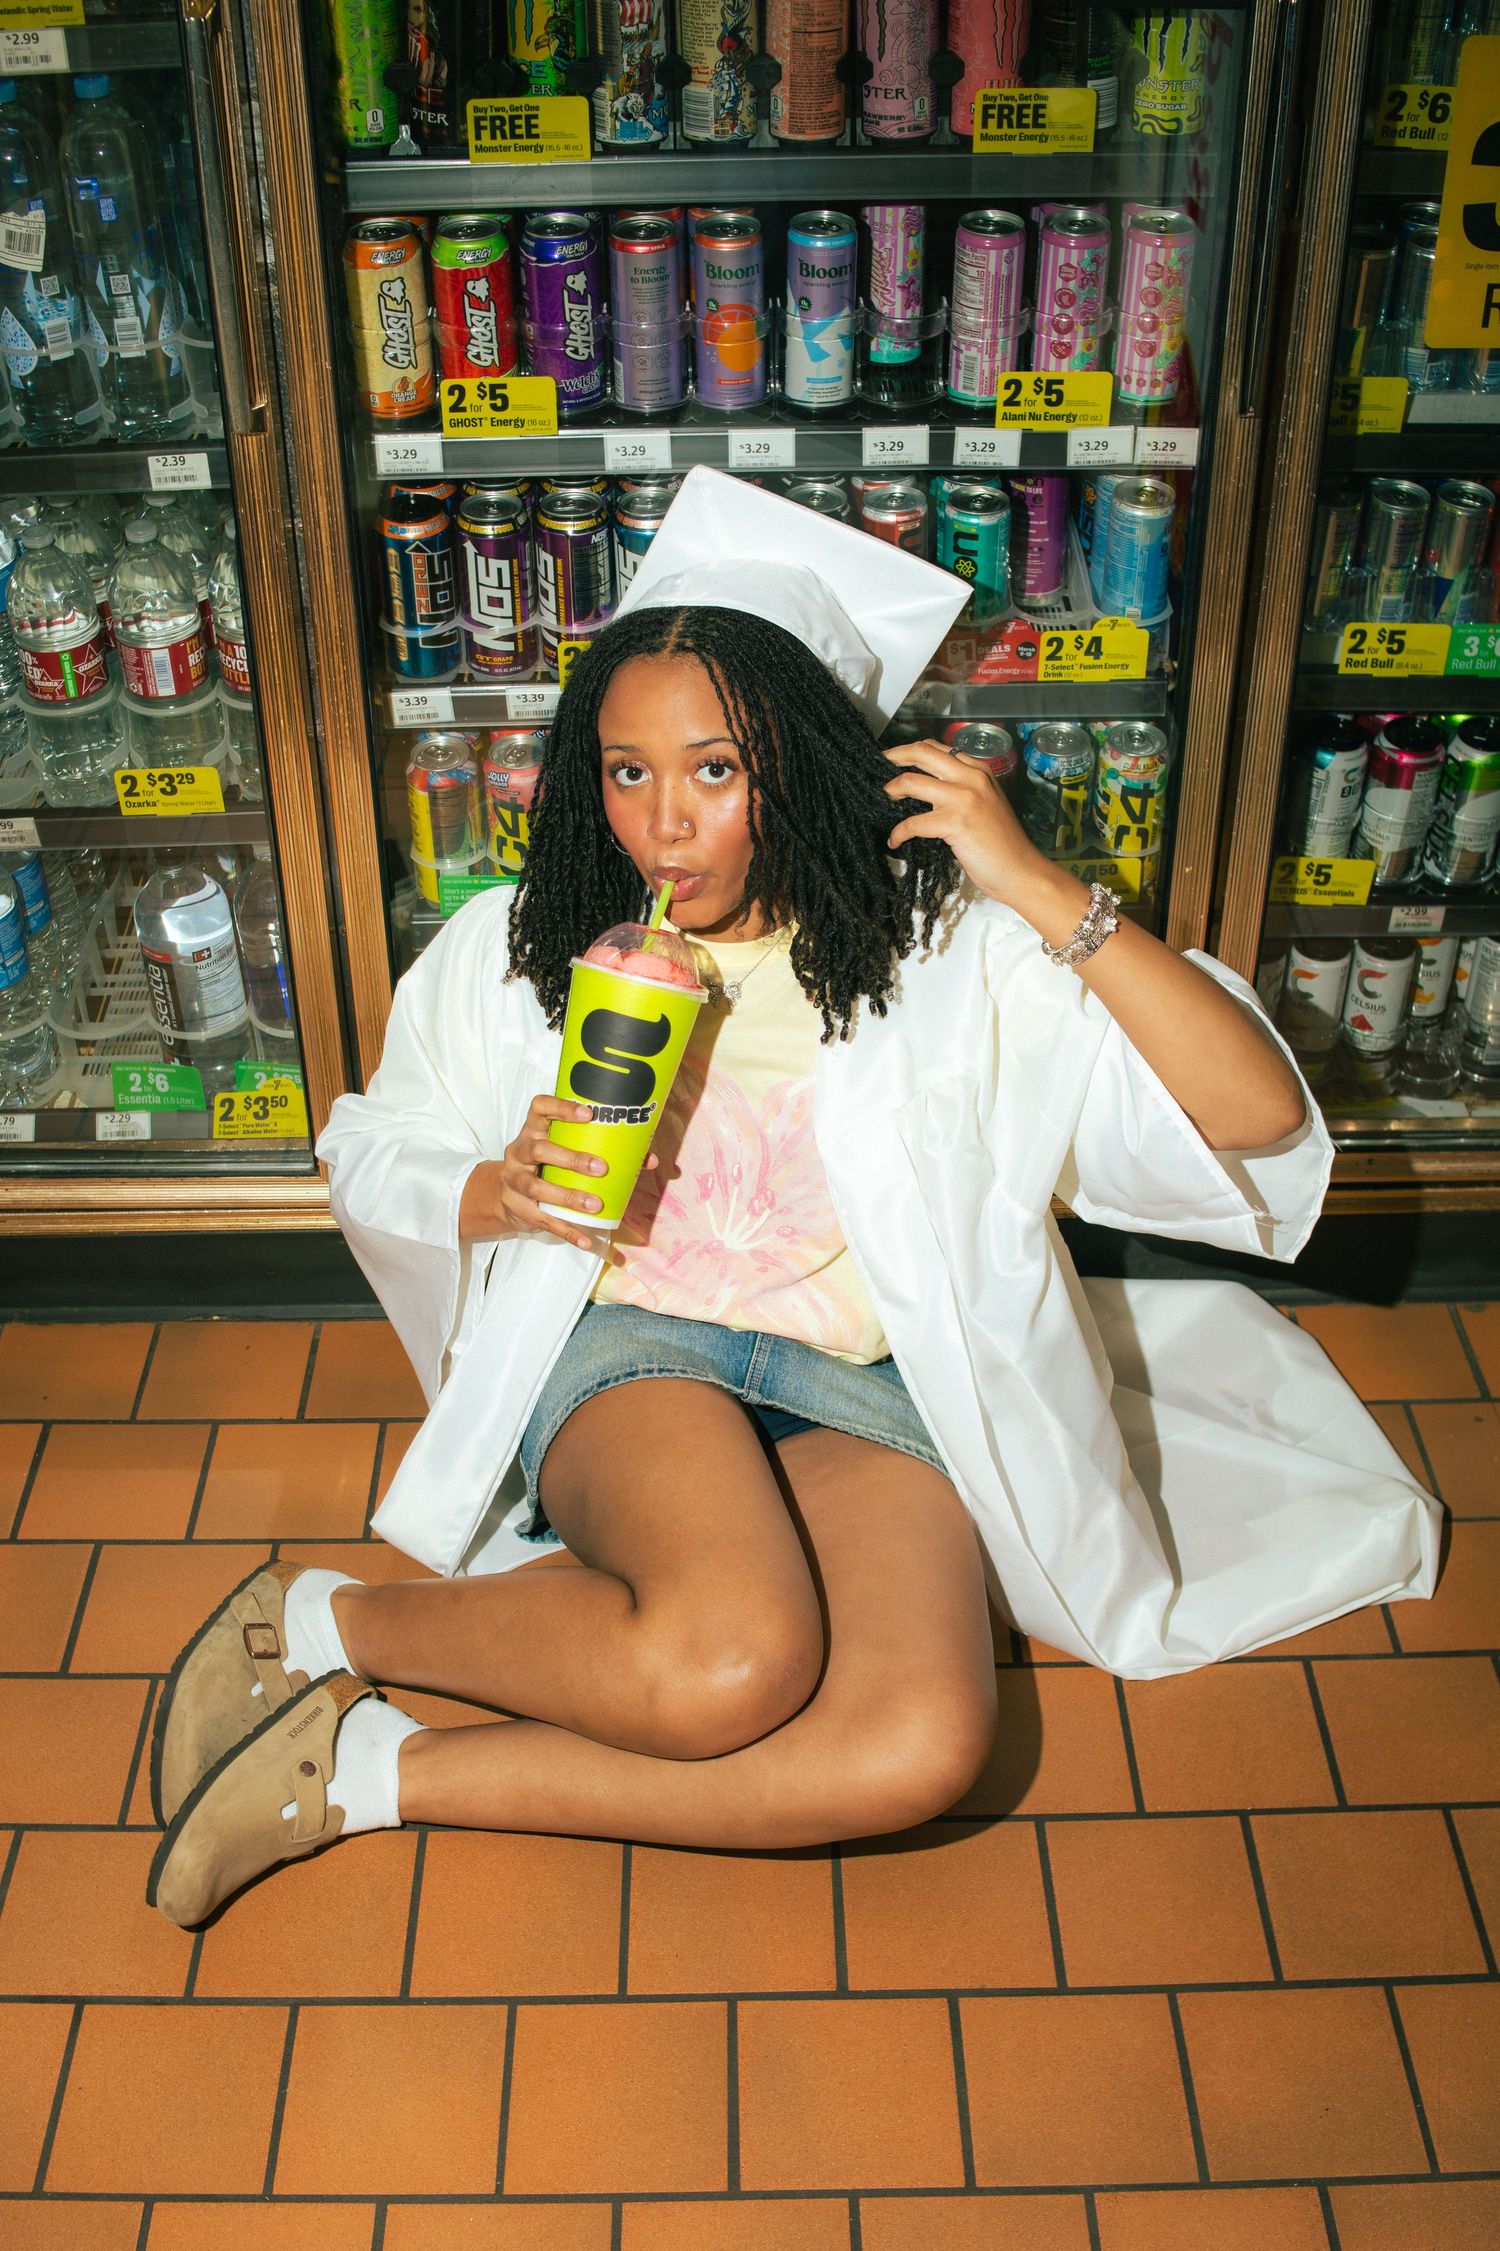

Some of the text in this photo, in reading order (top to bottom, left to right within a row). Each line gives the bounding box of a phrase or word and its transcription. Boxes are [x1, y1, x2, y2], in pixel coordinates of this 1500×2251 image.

[27, 6, 51, 15] Spring
[6, 32, 40, 46] $2.99
[983, 93, 1049, 103] Buy Two, Get One
[473, 103, 540, 114] Buy Two, Get One
[1156, 103, 1188, 111] SUGAR
[1384, 89, 1450, 124] 2 for $6
[981, 103, 1047, 129] FREE
[473, 114, 541, 140] FREE
[1381, 125, 1435, 140] Red Bull
[980, 132, 1017, 142] Monster
[1019, 132, 1049, 143] Energy
[474, 144, 512, 153] Monster
[513, 143, 544, 154] Energy
[556, 240, 588, 256] ENERGY
[370, 248, 405, 263] ENERGY
[456, 248, 492, 261] ENERGY
[633, 264, 667, 275] Energy
[704, 261, 760, 281] Bloom
[799, 259, 853, 279] Bloom
[630, 273, 670, 284] to Bloom
[378, 293, 418, 369] GHOST
[463, 291, 500, 368] GHOST
[563, 288, 596, 362] GHOST
[447, 381, 510, 413] 2 for $5
[1002, 376, 1065, 407] 2 for $5
[490, 416, 526, 429] Energy
[1001, 411, 1027, 421] Alani
[1027, 412, 1042, 421] Nu
[1043, 412, 1078, 423] Energy
[615, 445, 646, 457] $3.29
[739, 443, 770, 455] $3.29
[872, 441, 904, 452] $3.29
[964, 442, 995, 453] $3.29
[1077, 440, 1109, 451] $3.29
[1146, 440, 1177, 452] $3.29
[386, 448, 417, 460] $3.29
[155, 455, 186, 467] $2.39
[1033, 486, 1043, 494] LIFE
[413, 554, 431, 613] ZERO
[463, 540, 515, 652] NOS
[1347, 627, 1407, 656] 2 for $5
[1463, 635, 1480, 657] 3
[1045, 634, 1103, 662] 2 for $4
[1104, 662, 1129, 671] Energy
[1345, 657, 1368, 669] Red
[1370, 657, 1394, 669] Bull
[1451, 659, 1497, 670] Red Bull
[978, 667, 1020, 676] Fusion Energy
[1043, 671, 1063, 679] Drink
[399, 696, 428, 707] $3.39
[515, 693, 545, 703] $3.39
[487, 772, 510, 784] JOLLY
[120, 774, 140, 797] 2
[142, 789, 155, 797] for
[1114, 783, 1156, 854] C4
[1276, 862, 1297, 885] 2
[1304, 861, 1333, 886] $5
[1313, 887, 1355, 897] Essentials
[1400, 907, 1428, 916] $2.99
[1350, 993, 1387, 1013] CELSIUS
[128, 1071, 170, 1093] 2 for $6
[118, 1093, 161, 1105] Essentia
[219, 1097, 235, 1122] 2
[236, 1113, 248, 1122] for
[105, 1113, 131, 1123] $2.29
[286, 1705, 325, 1740] BIRKENSTOCK
